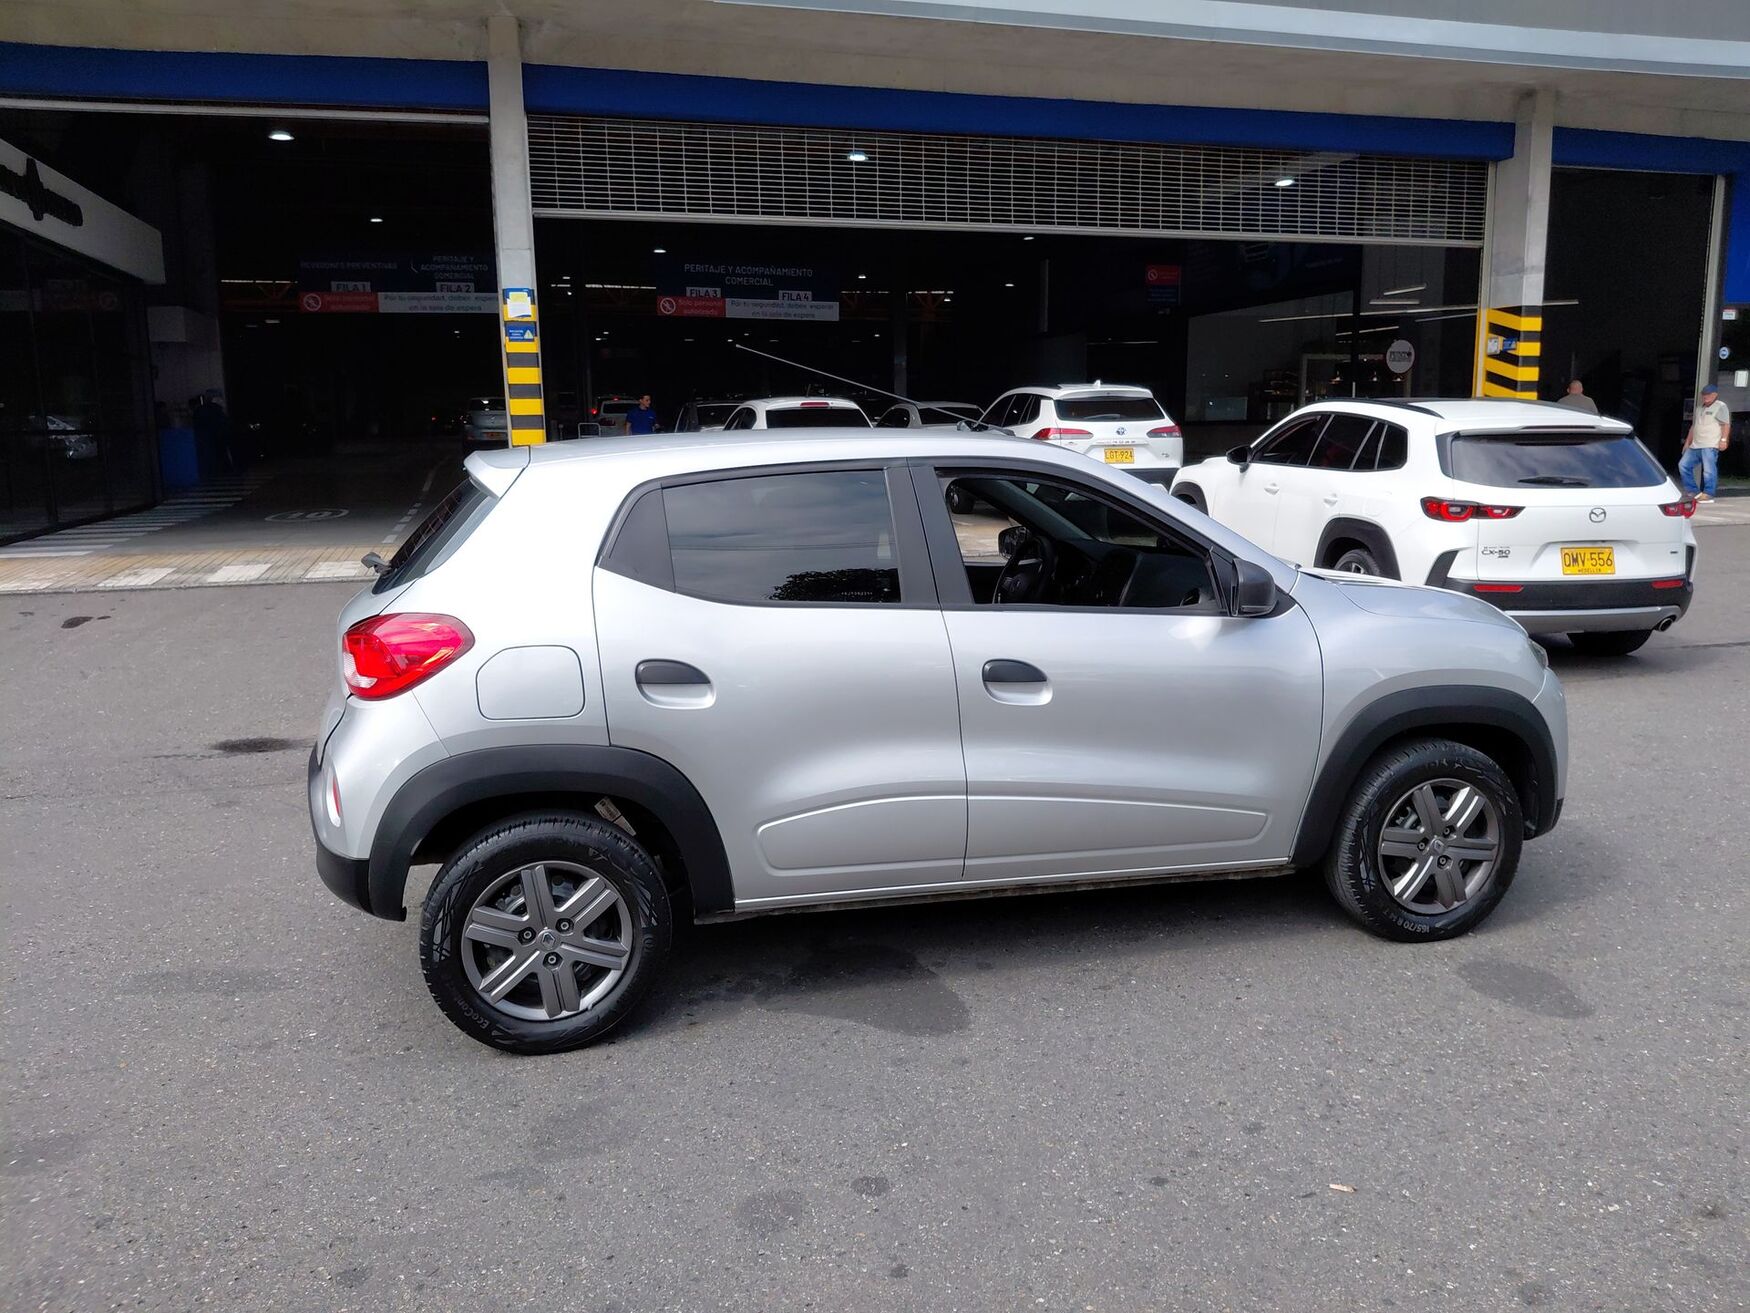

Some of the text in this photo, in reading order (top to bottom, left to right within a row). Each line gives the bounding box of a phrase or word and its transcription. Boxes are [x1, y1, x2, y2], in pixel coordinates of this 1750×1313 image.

[684, 263, 726, 274] PERITAJE
[735, 264, 813, 278] ACOMPAÑAMIENTO
[725, 276, 774, 286] COMERCIAL
[336, 283, 360, 291] FILA
[440, 284, 463, 292] FILA
[689, 288, 718, 298] FILA 3
[782, 292, 809, 302] FILA 4
[1589, 552, 1613, 567] 556
